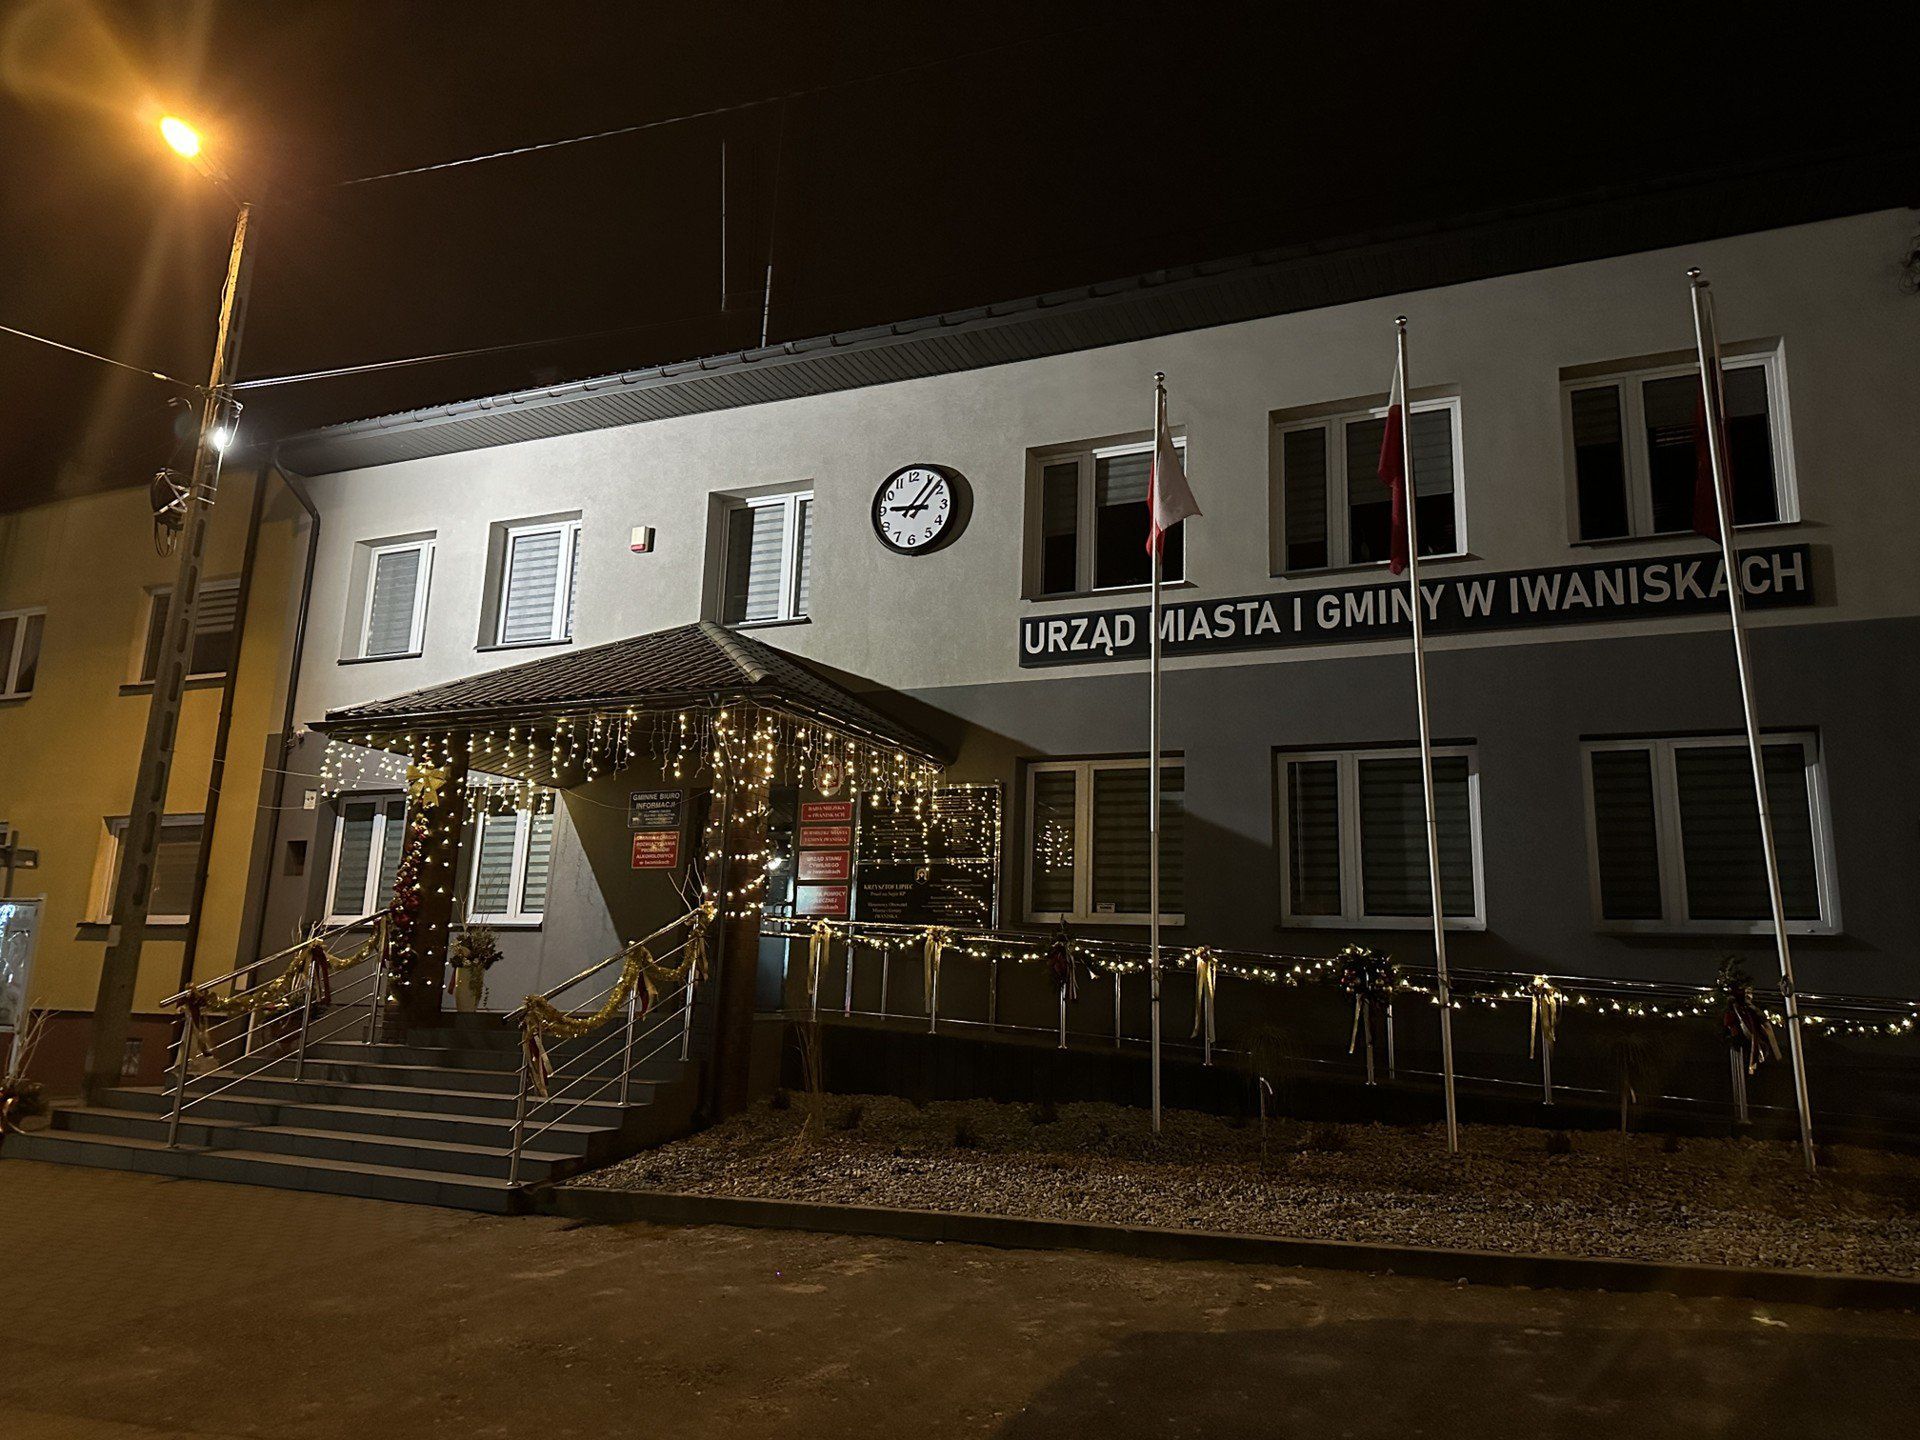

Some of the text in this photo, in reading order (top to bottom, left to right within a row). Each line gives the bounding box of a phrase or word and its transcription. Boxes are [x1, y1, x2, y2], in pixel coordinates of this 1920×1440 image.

[908, 471, 920, 483] 12
[896, 478, 904, 490] 11
[936, 484, 944, 495] 2
[939, 498, 948, 510] 3
[880, 506, 887, 517] 9
[934, 514, 943, 526] 4
[882, 521, 891, 533] 8
[924, 527, 933, 539] 5
[893, 530, 902, 543] 7
[907, 534, 916, 546] 6
[1024, 551, 1805, 656] URZĄD MIASTA I GMINY W IWANISKACH
[660, 792, 680, 800] BIURO
